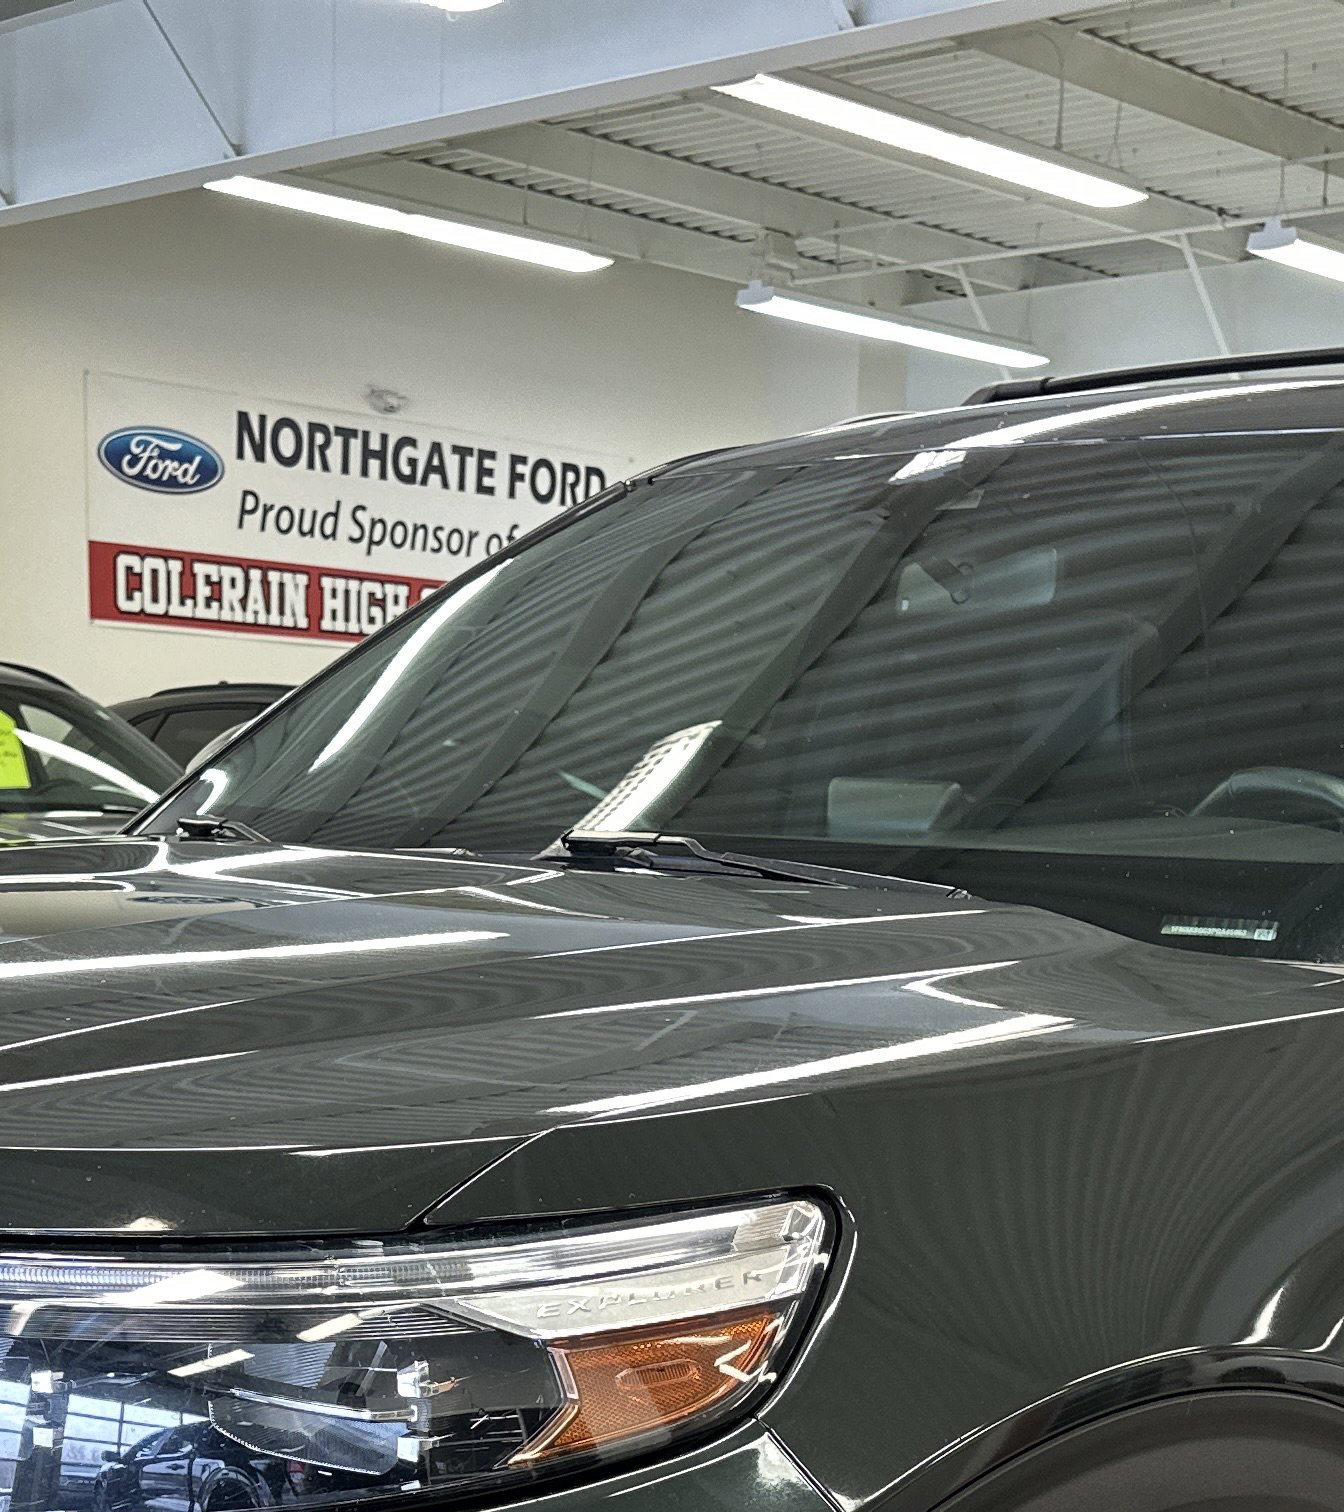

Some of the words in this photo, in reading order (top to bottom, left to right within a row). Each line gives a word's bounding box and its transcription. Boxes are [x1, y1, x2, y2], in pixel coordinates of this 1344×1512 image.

[120, 429, 201, 485] Ford
[236, 410, 497, 497] NORTHGATE
[508, 453, 606, 507] FORD
[237, 490, 341, 541] Proud
[349, 504, 479, 558] Sponsor
[114, 552, 310, 631] COLERAIN
[319, 571, 411, 637] HIGH
